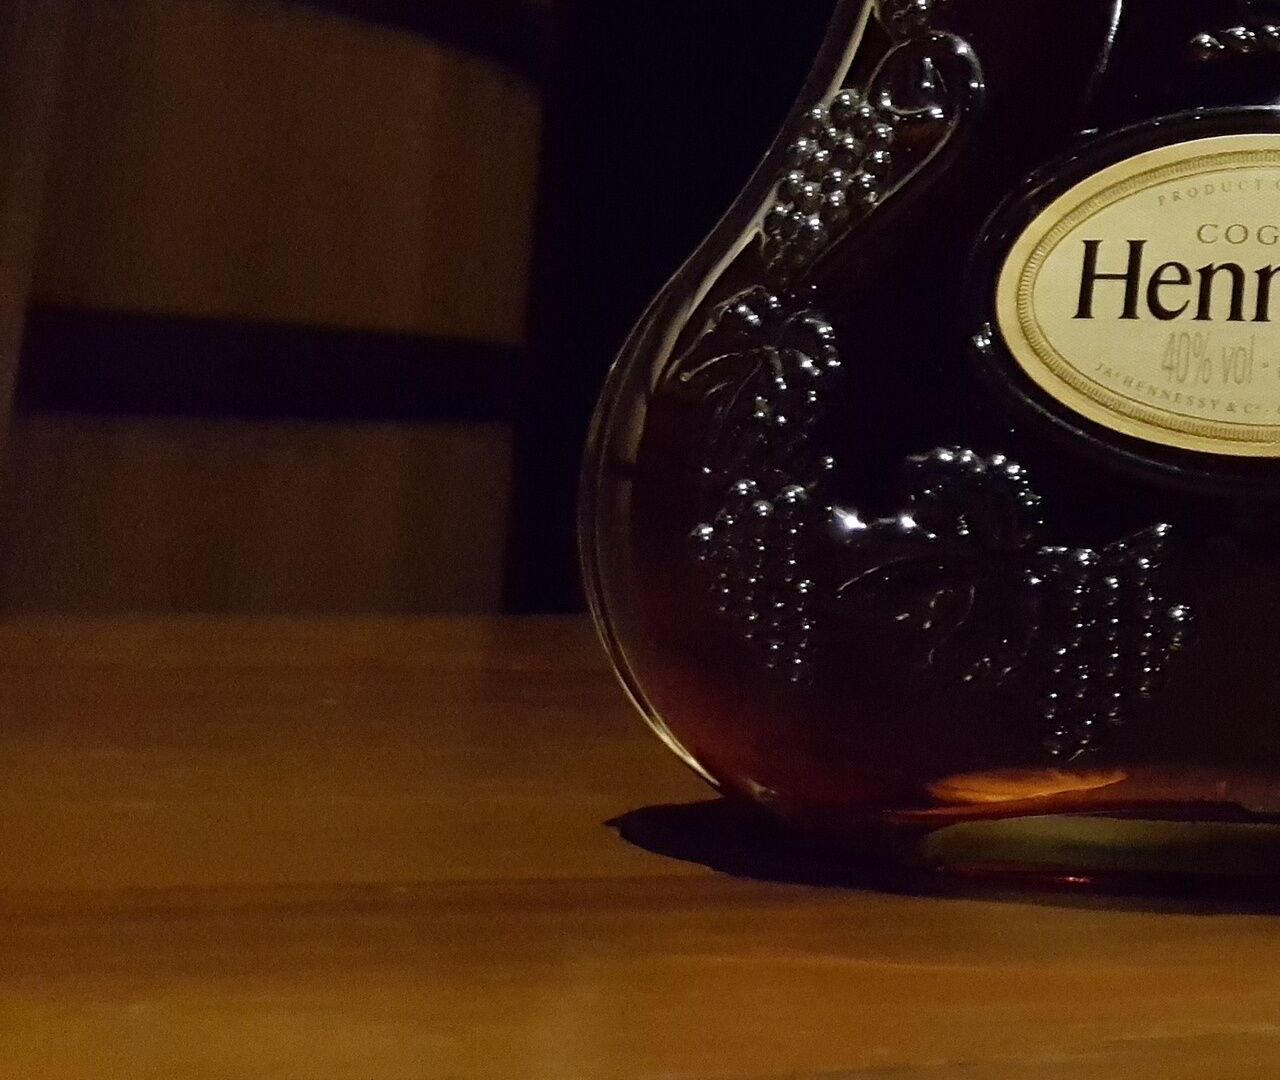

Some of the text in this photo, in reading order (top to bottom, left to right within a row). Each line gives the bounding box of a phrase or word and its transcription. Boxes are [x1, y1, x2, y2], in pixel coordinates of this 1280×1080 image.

[1157, 178, 1264, 206] PRODUCT
[1162, 331, 1213, 384] 40%
[1222, 332, 1255, 385] vol
[1123, 375, 1220, 410] HENNESSY
